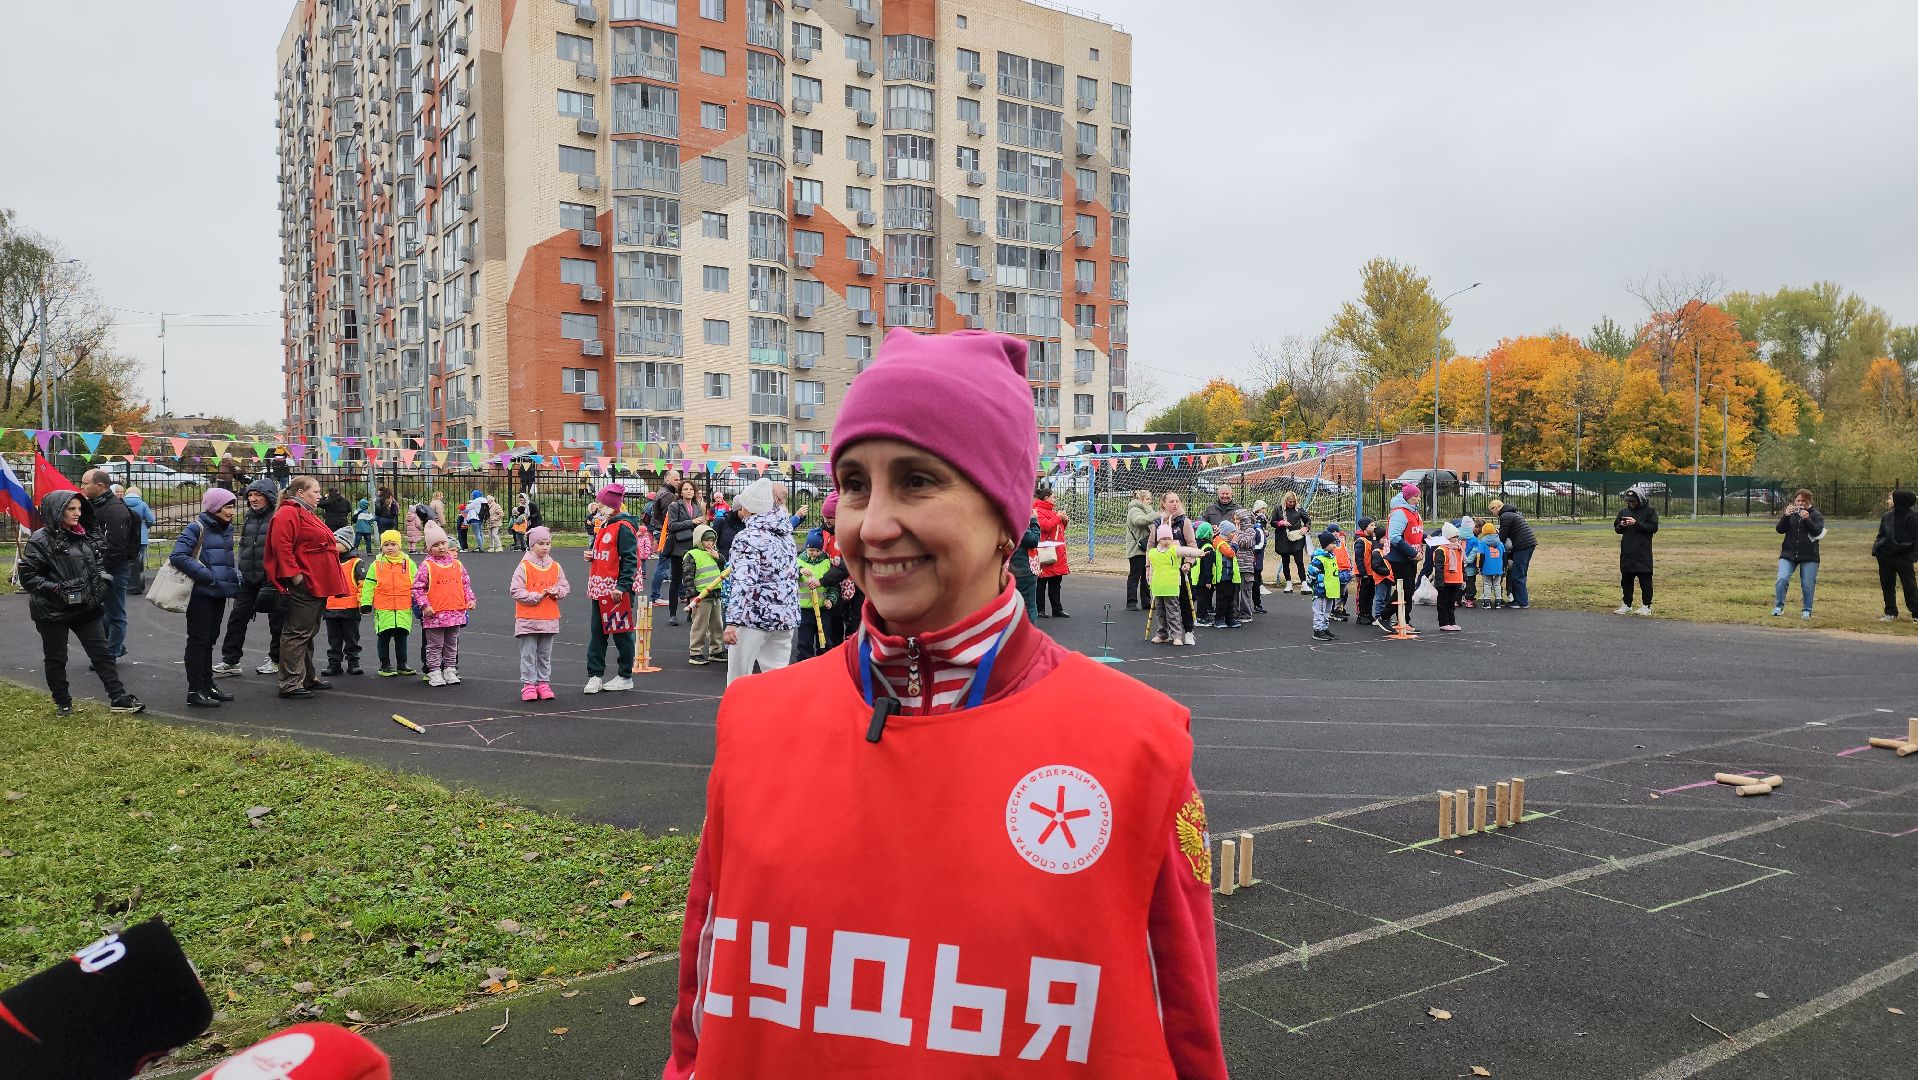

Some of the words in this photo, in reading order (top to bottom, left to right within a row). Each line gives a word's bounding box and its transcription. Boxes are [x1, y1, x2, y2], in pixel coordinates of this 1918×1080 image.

[1029, 769, 1097, 791] ФЕДЕРАЦИЯ
[1010, 784, 1028, 832] РОССИИ
[1062, 793, 1109, 869] ГОРОДОШНОГО
[1016, 836, 1056, 868] СПОРТА
[703, 917, 1101, 1065] СУДЬЯ
